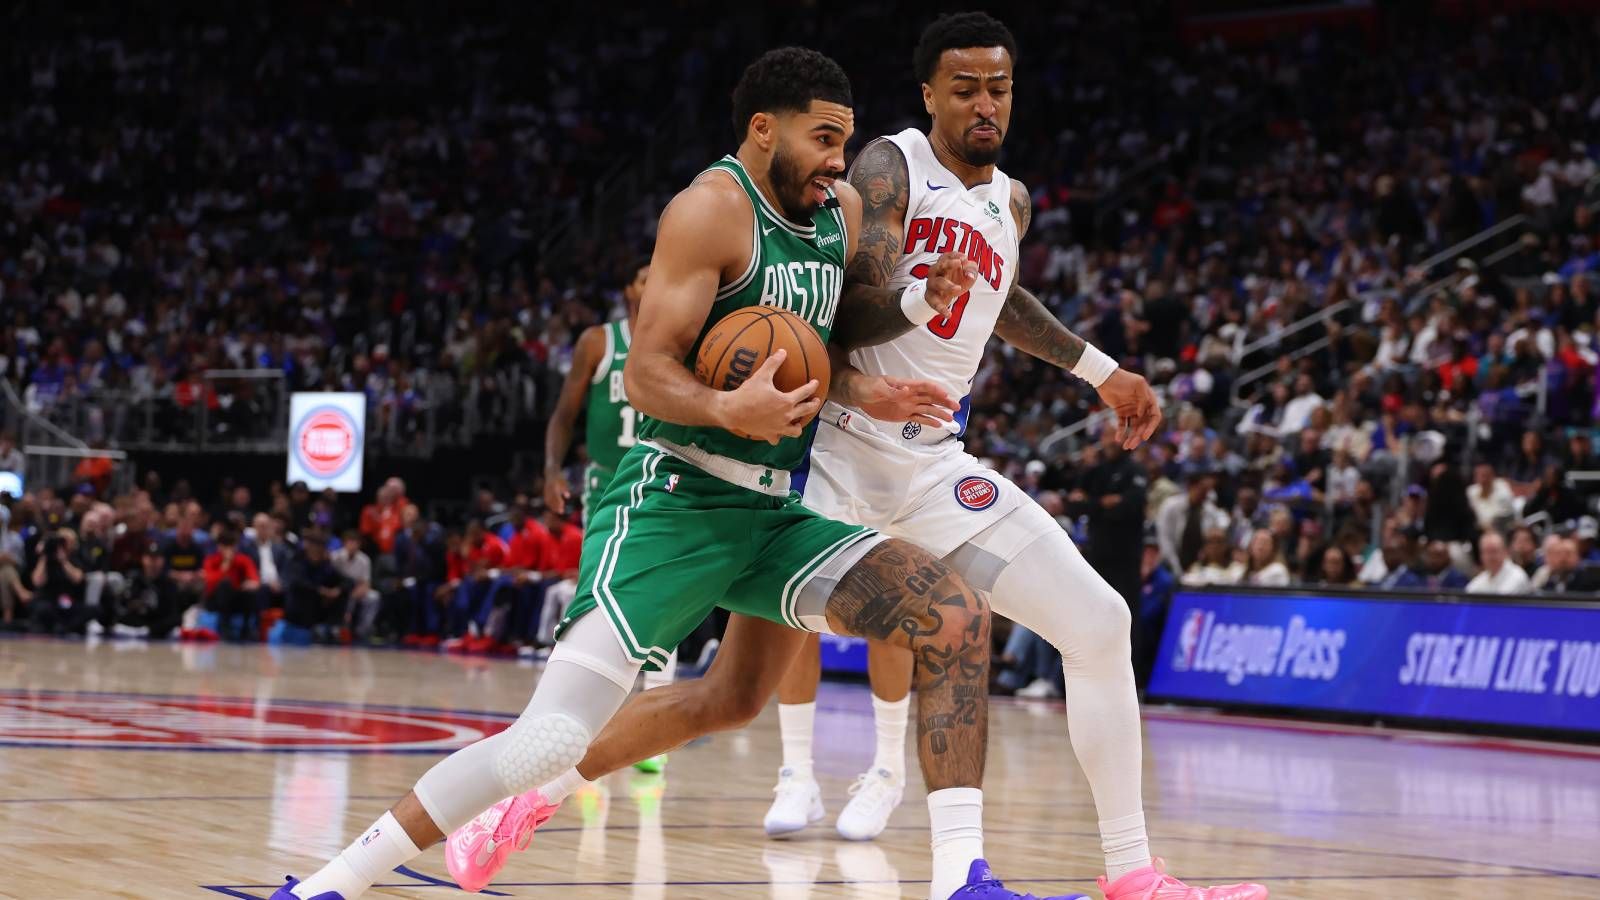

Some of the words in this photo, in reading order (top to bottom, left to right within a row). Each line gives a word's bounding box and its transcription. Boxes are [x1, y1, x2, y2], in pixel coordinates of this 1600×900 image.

[815, 232, 840, 247] Amica
[904, 217, 1004, 291] PISTONS
[966, 487, 991, 502] PISTONS
[1193, 610, 1284, 686] League
[1276, 614, 1347, 681] Pass
[1398, 632, 1500, 690] STREAM
[1494, 637, 1558, 694] LIKE
